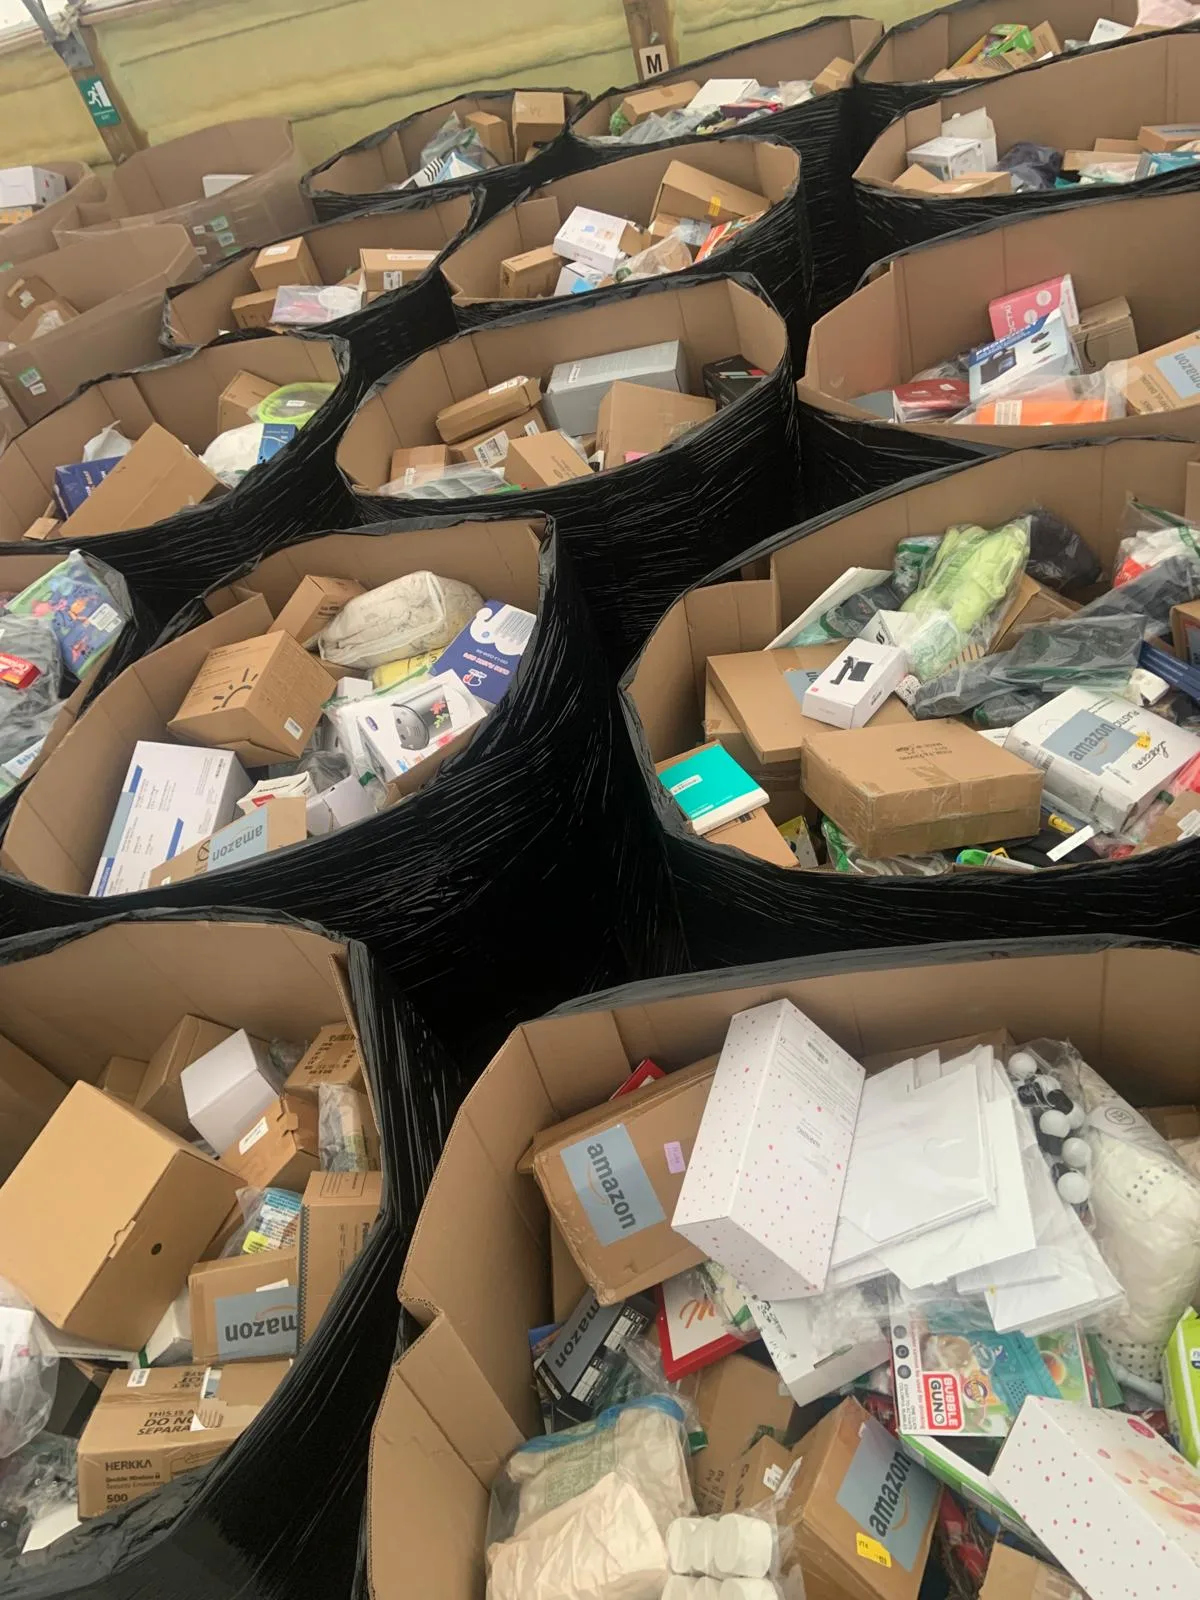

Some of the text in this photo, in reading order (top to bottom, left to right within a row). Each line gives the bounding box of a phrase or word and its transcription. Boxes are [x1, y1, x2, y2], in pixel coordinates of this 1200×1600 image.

[646, 53, 662, 75] M
[1068, 722, 1115, 761] amazon
[212, 823, 263, 862] amazon
[586, 1142, 638, 1230] amazon
[225, 1314, 297, 1342] mazon
[554, 1298, 600, 1368] mazon
[931, 1380, 944, 1412] GUN
[944, 1377, 958, 1426] BUBBLE
[144, 1417, 169, 1427] DO
[149, 1410, 171, 1418] THIS
[137, 1425, 191, 1435] SEPARA
[105, 1459, 152, 1472] HERKKA
[106, 1493, 128, 1503] 500
[869, 1450, 912, 1539] amazon
